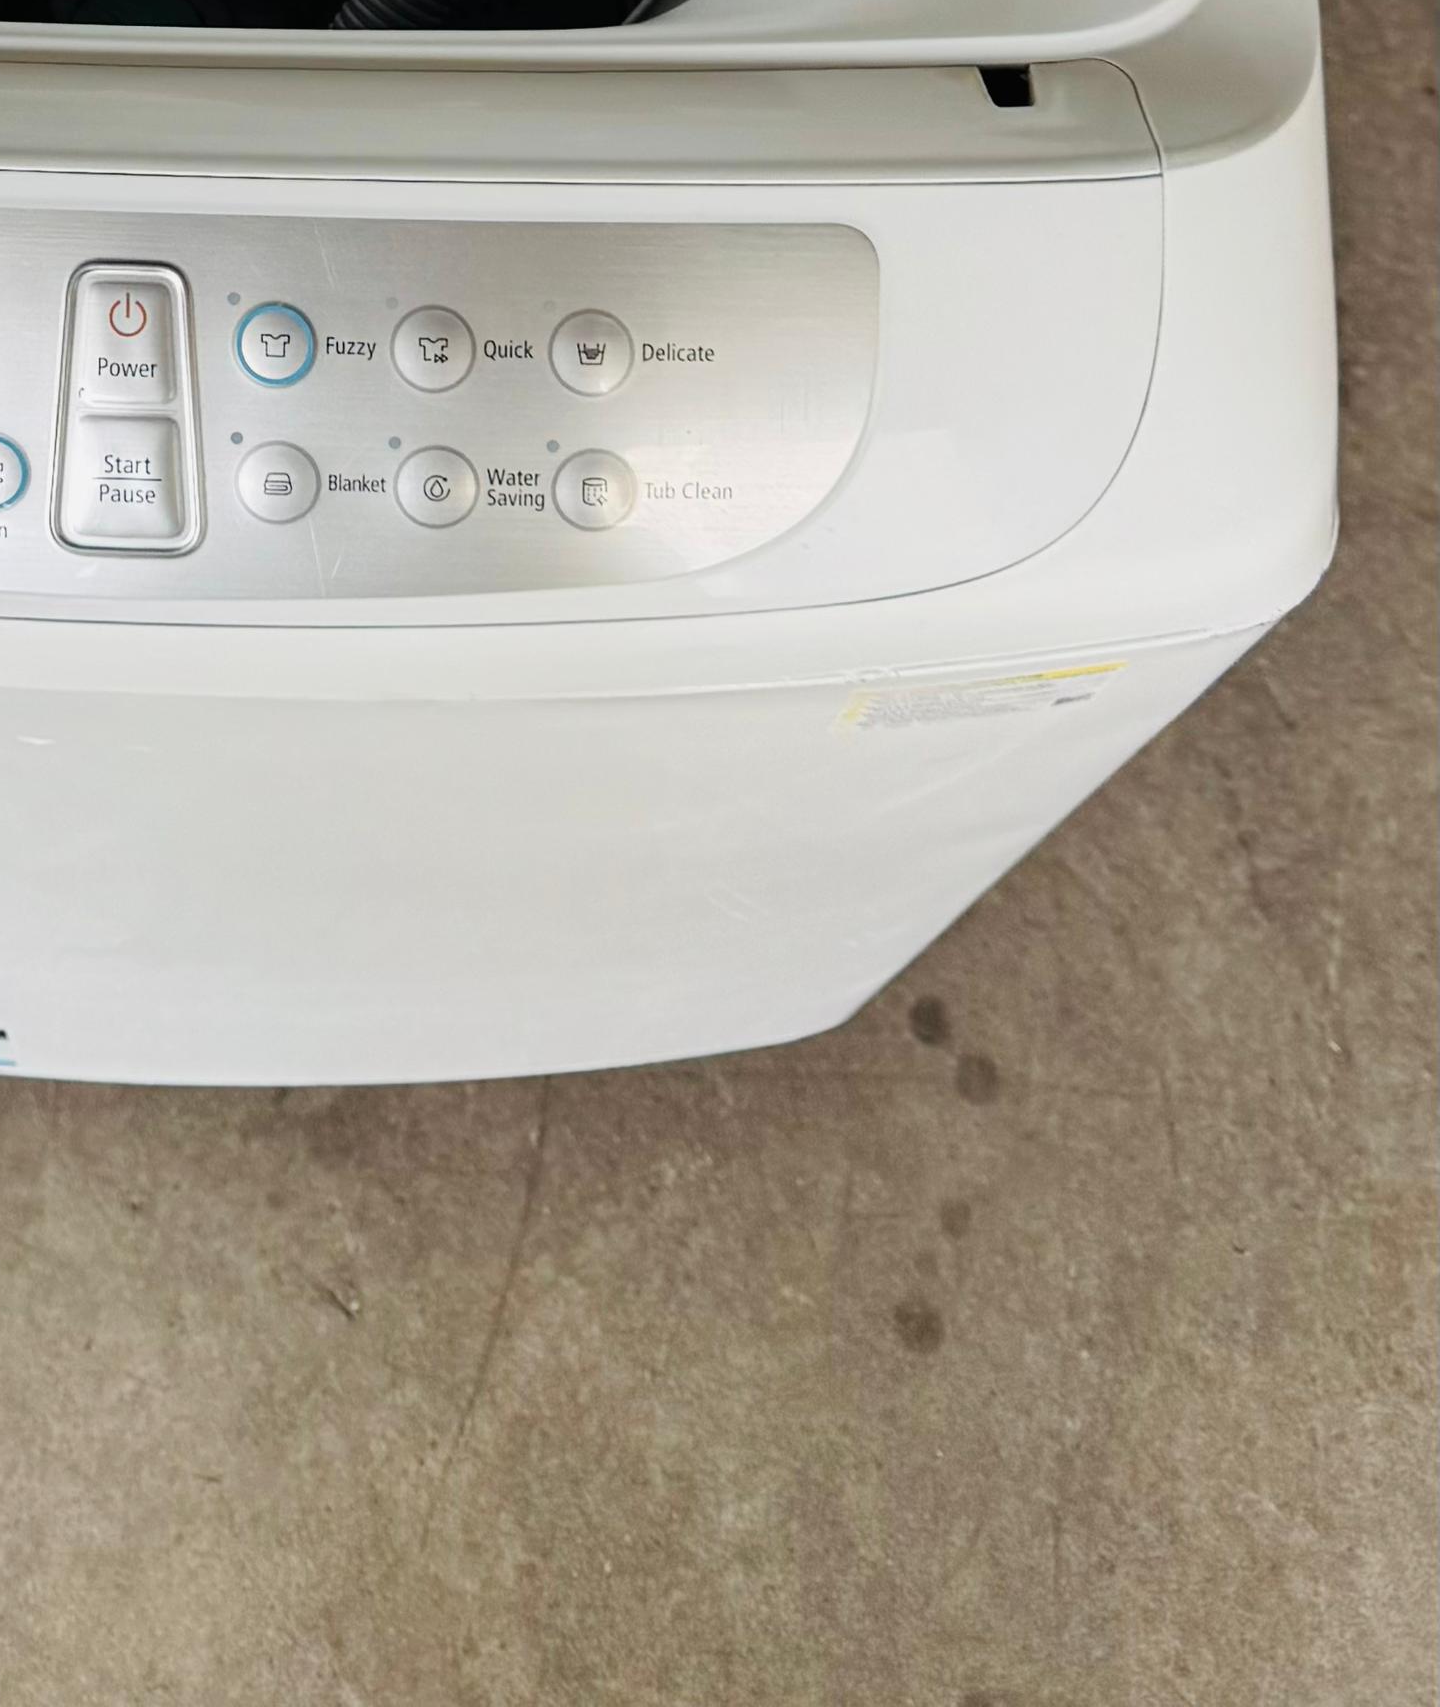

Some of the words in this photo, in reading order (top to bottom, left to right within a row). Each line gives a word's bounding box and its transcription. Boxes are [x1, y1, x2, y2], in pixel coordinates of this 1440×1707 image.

[325, 336, 378, 357] Fuzzy
[483, 339, 535, 360] Quick
[641, 342, 716, 362] Delicate
[97, 357, 159, 379] Power
[102, 454, 152, 476] Start
[327, 473, 387, 494] Blanket
[486, 468, 541, 487] Water
[98, 483, 157, 505] Pause
[486, 488, 546, 512] Saving
[644, 480, 677, 501] Tub
[681, 480, 734, 501] Clean
